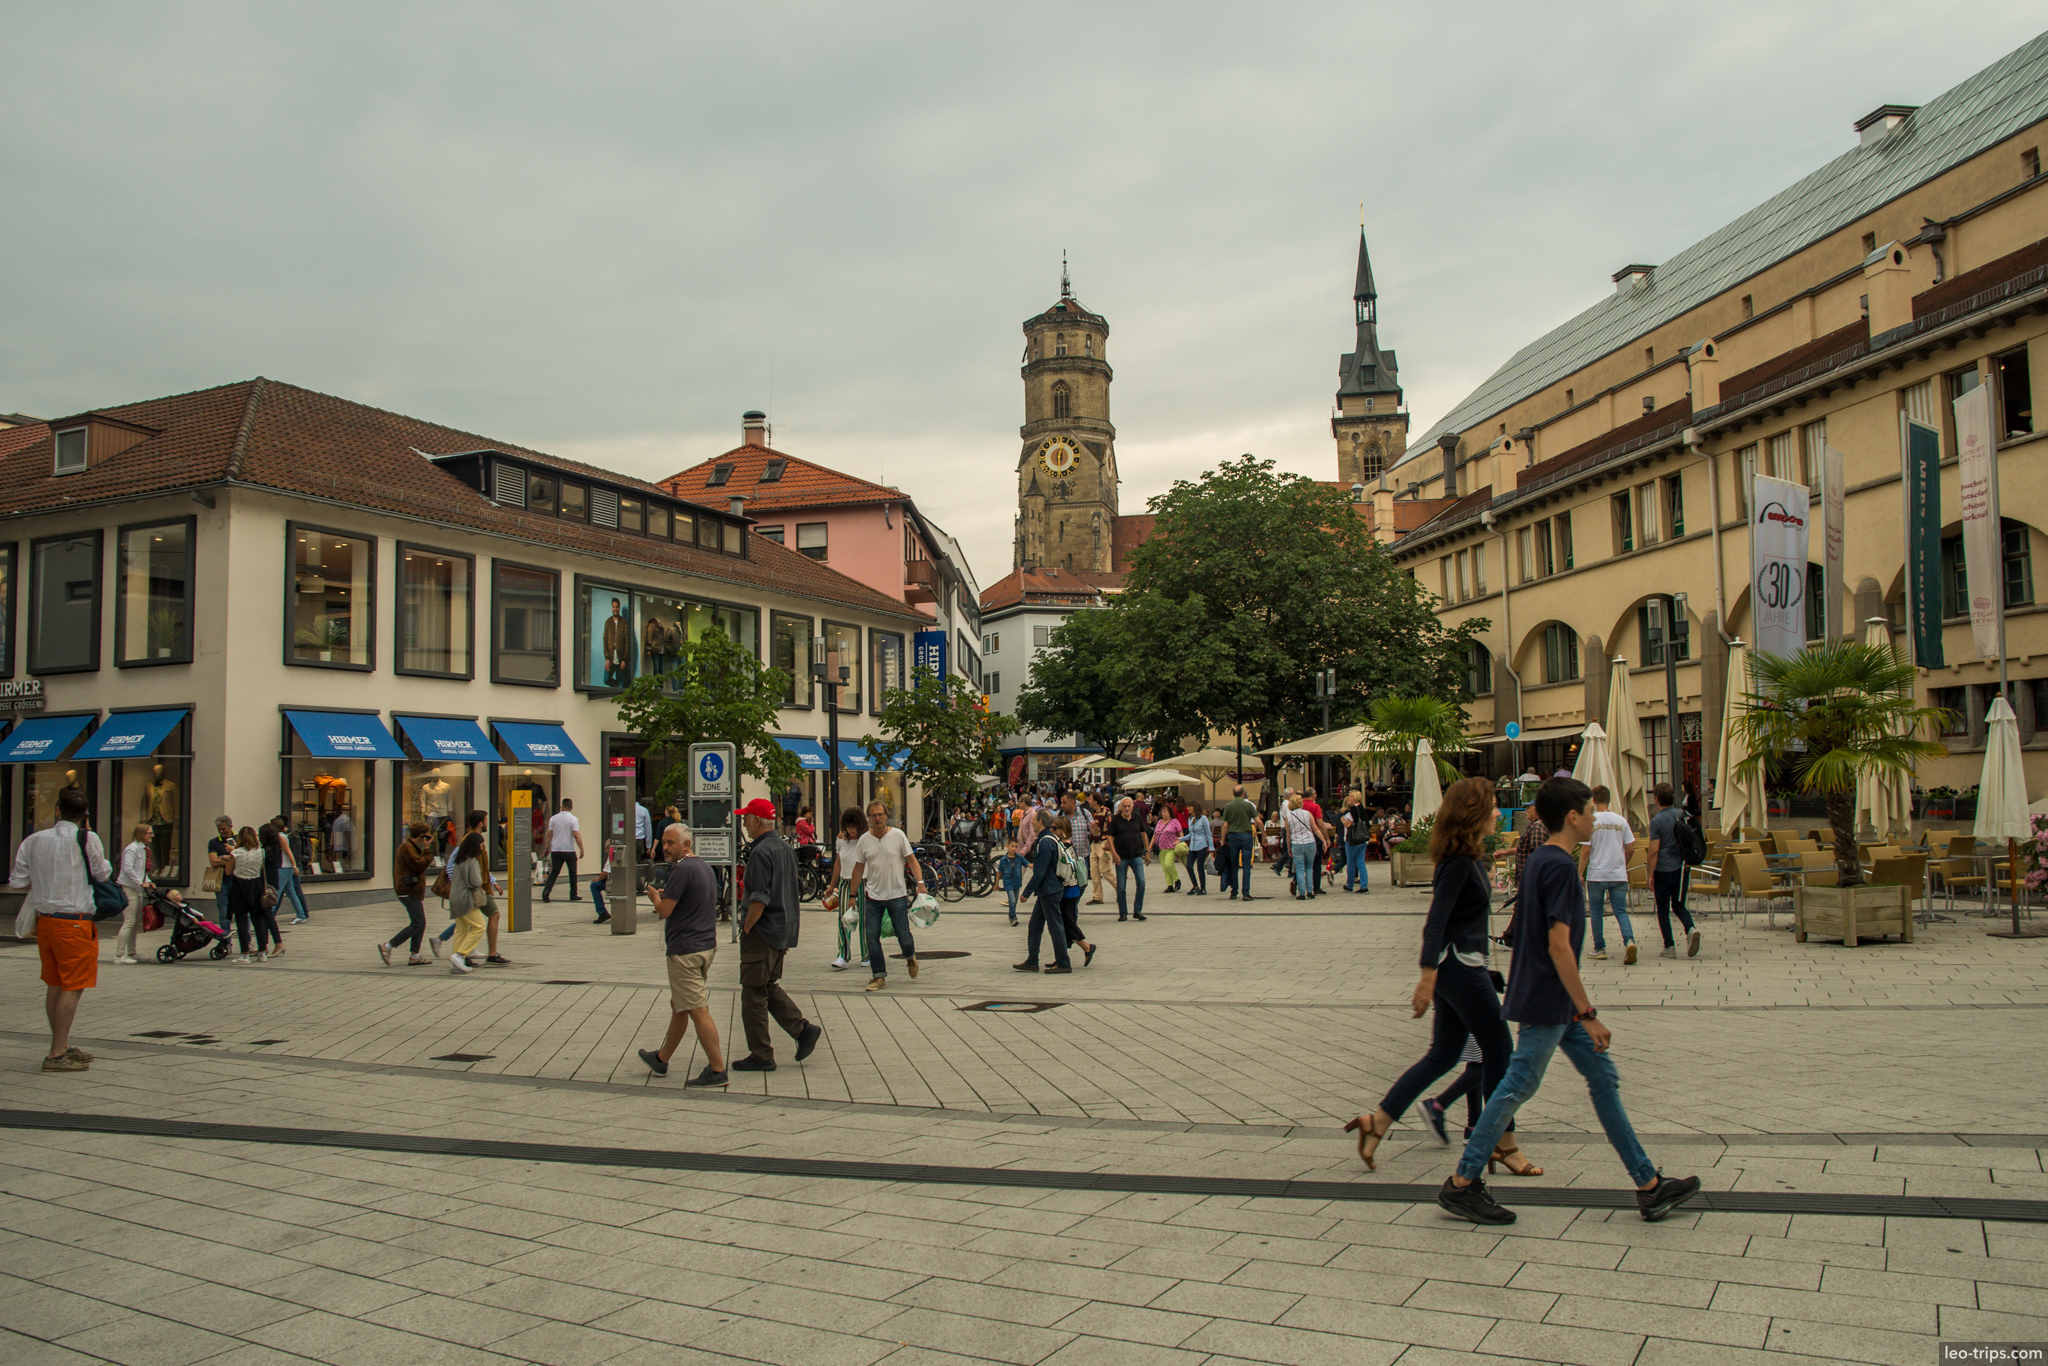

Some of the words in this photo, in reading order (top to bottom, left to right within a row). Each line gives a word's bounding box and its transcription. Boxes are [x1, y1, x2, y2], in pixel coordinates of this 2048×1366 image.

[1768, 561, 1790, 610] 30
[1763, 610, 1791, 625] JAHRE
[0, 680, 40, 696] IRMER
[106, 735, 145, 744] HIRMER
[328, 735, 372, 744] HIRMER
[16, 740, 53, 749] HIRMER
[434, 740, 473, 749] HIRMER
[527, 743, 561, 751] HIRMER
